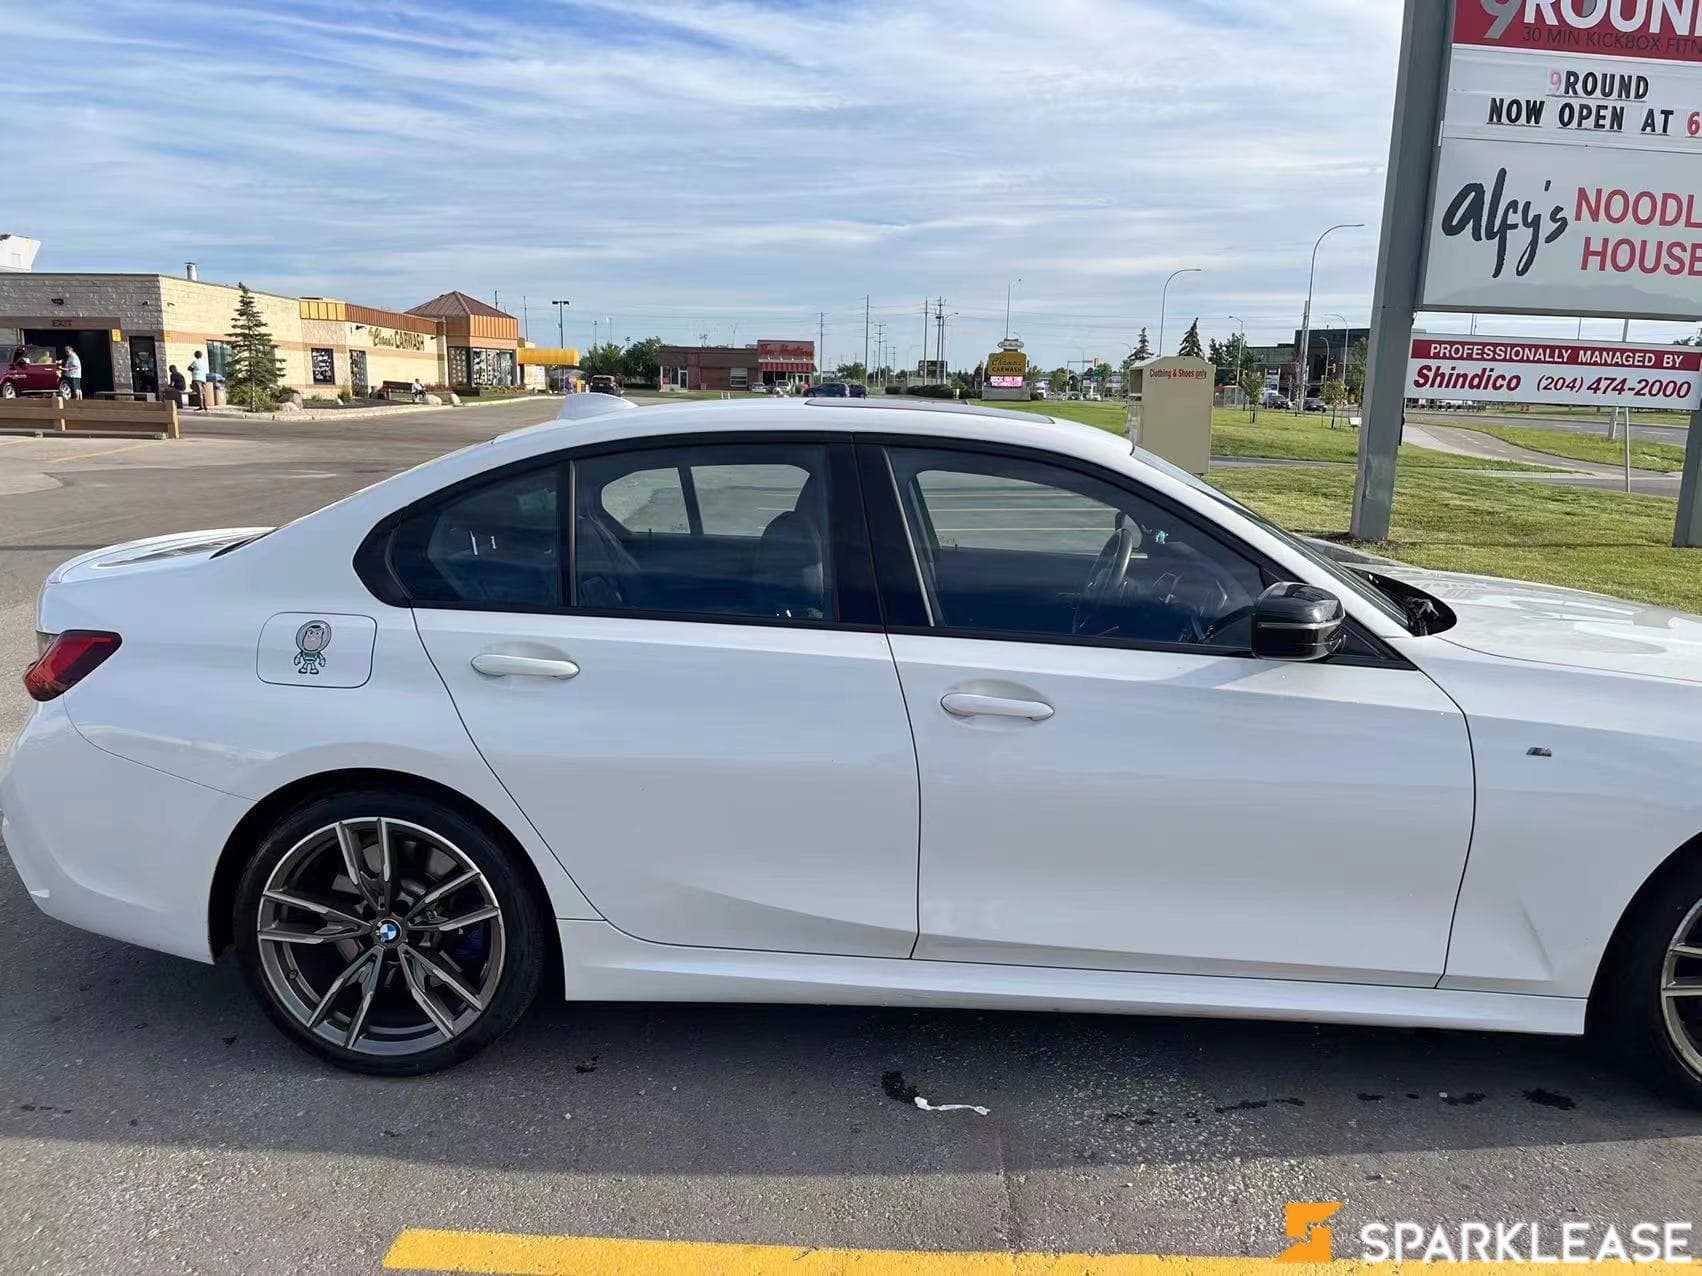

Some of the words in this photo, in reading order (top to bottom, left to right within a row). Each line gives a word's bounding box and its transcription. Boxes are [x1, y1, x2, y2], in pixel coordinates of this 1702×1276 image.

[1481, 0, 1702, 39] 9ROUN
[1523, 26, 1541, 42] 30
[1547, 29, 1581, 46] MIN
[1586, 32, 1661, 51] KICKBOX
[1550, 70, 1649, 99] 9ROUND
[1488, 98, 1545, 125] NOW
[1558, 102, 1625, 131] OPEN
[1641, 108, 1674, 134] AT
[1441, 168, 1568, 278] alfy's
[1574, 186, 1702, 229] NOODL
[1580, 236, 1702, 276] HOUSE
[1430, 343, 1571, 363] PROFESSIONALLY
[1578, 351, 1656, 367] MANAGED
[1662, 354, 1684, 367] BY
[1150, 368, 1171, 379] Clothing
[1172, 369, 1177, 378] &
[1178, 369, 1194, 378] Shoes
[1195, 369, 1207, 379] only
[1413, 365, 1522, 392] Shindico
[1536, 374, 1584, 393] (204)
[1586, 376, 1692, 399] 474-2000
